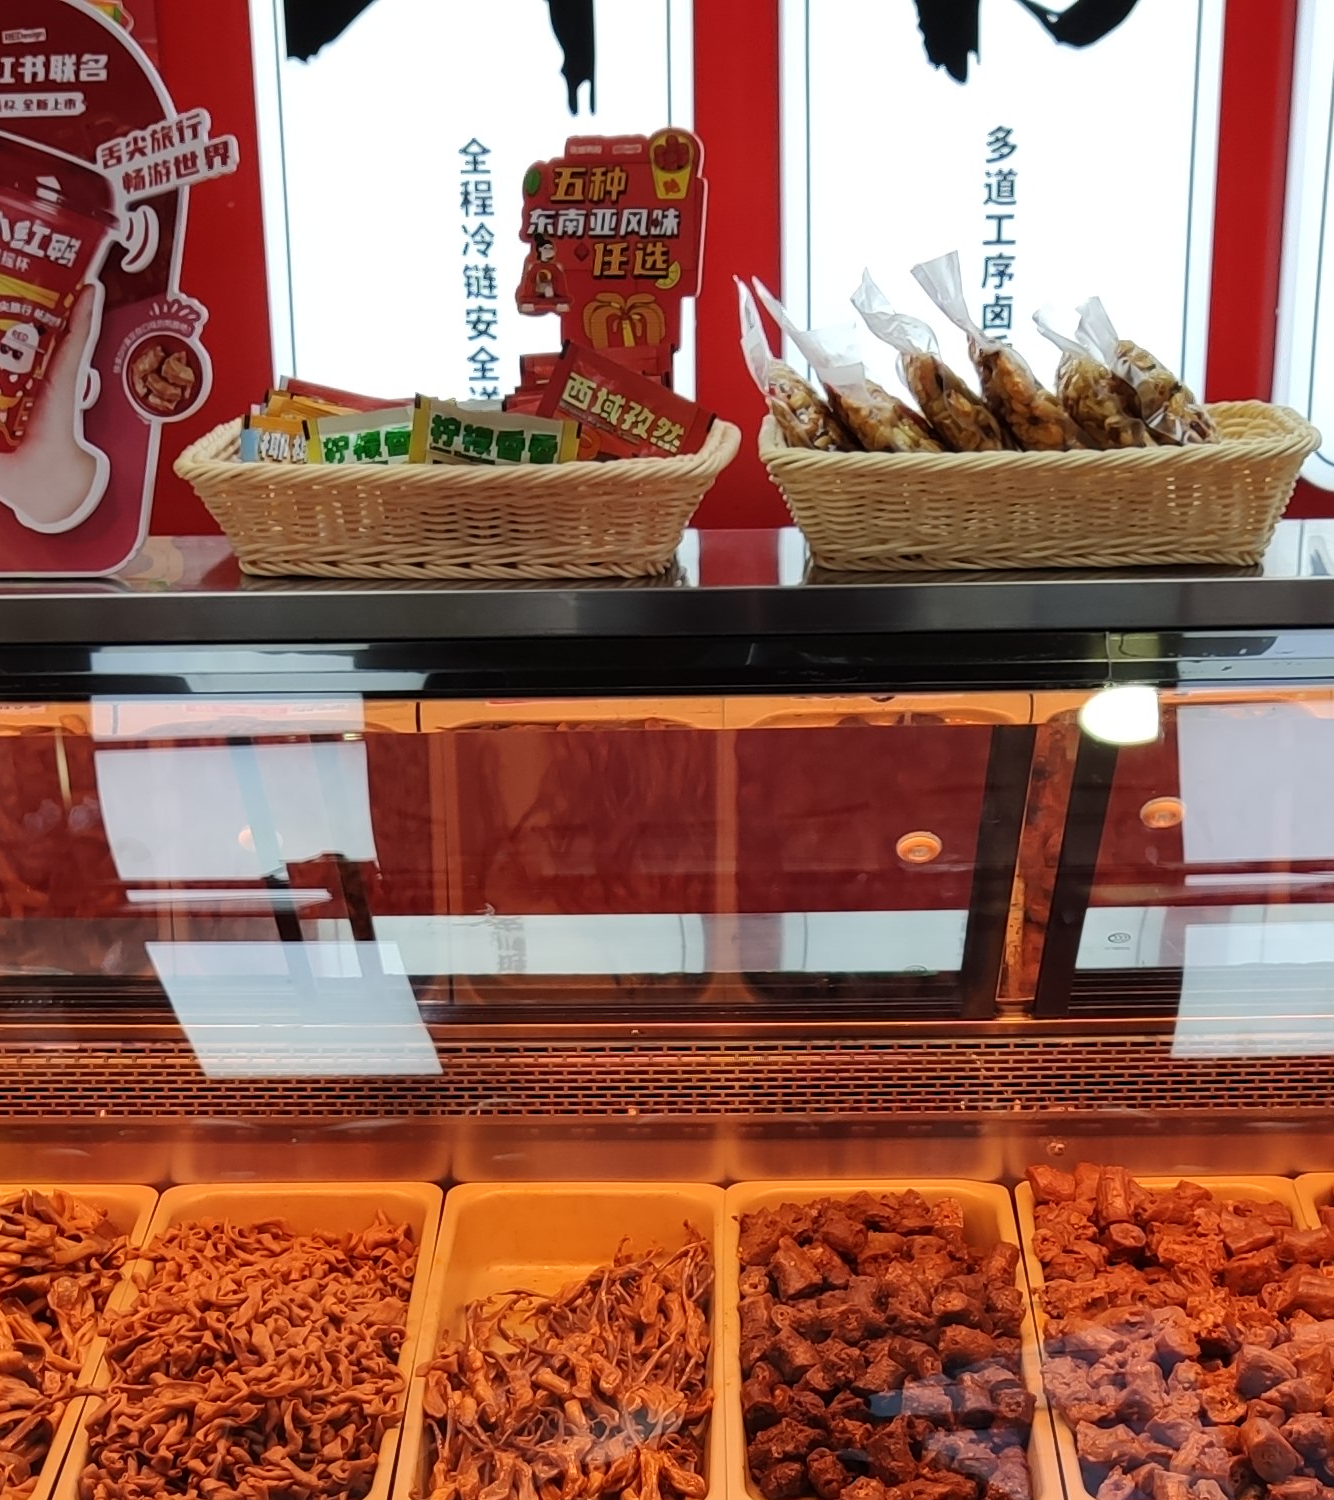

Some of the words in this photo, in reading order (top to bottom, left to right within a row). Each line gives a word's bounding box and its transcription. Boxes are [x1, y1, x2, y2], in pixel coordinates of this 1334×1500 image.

[101, 113, 203, 168] 舌尖旅行
[122, 141, 231, 195] 畅游世界
[550, 167, 626, 201] 五种
[527, 208, 680, 237] 东南亚风味
[981, 125, 1018, 347] 多道工序卤
[593, 242, 667, 277] 任选
[561, 372, 686, 454] 西域孜然
